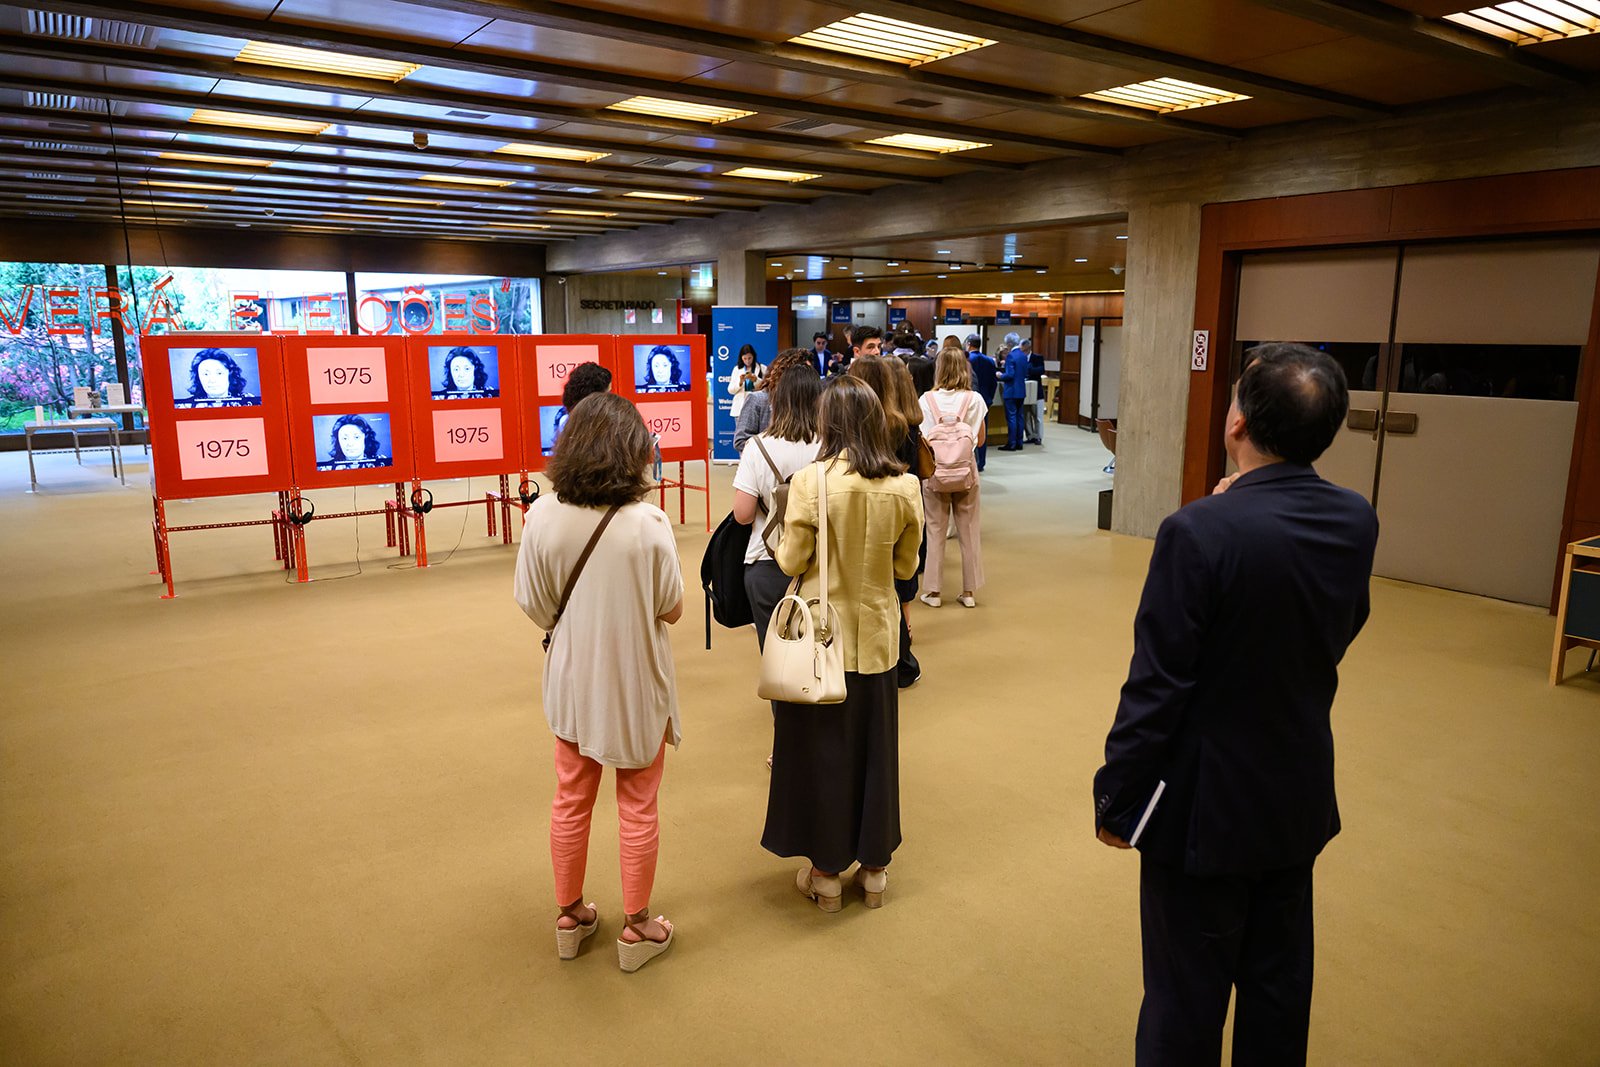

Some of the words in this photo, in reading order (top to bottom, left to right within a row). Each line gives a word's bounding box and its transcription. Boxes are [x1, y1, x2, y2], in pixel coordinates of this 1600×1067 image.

[580, 299, 656, 311] SECRETARIADO
[324, 367, 372, 386] 1975
[549, 363, 581, 379] 197
[647, 417, 681, 433] 1975
[447, 427, 490, 444] 1975
[196, 439, 250, 460] 1975
